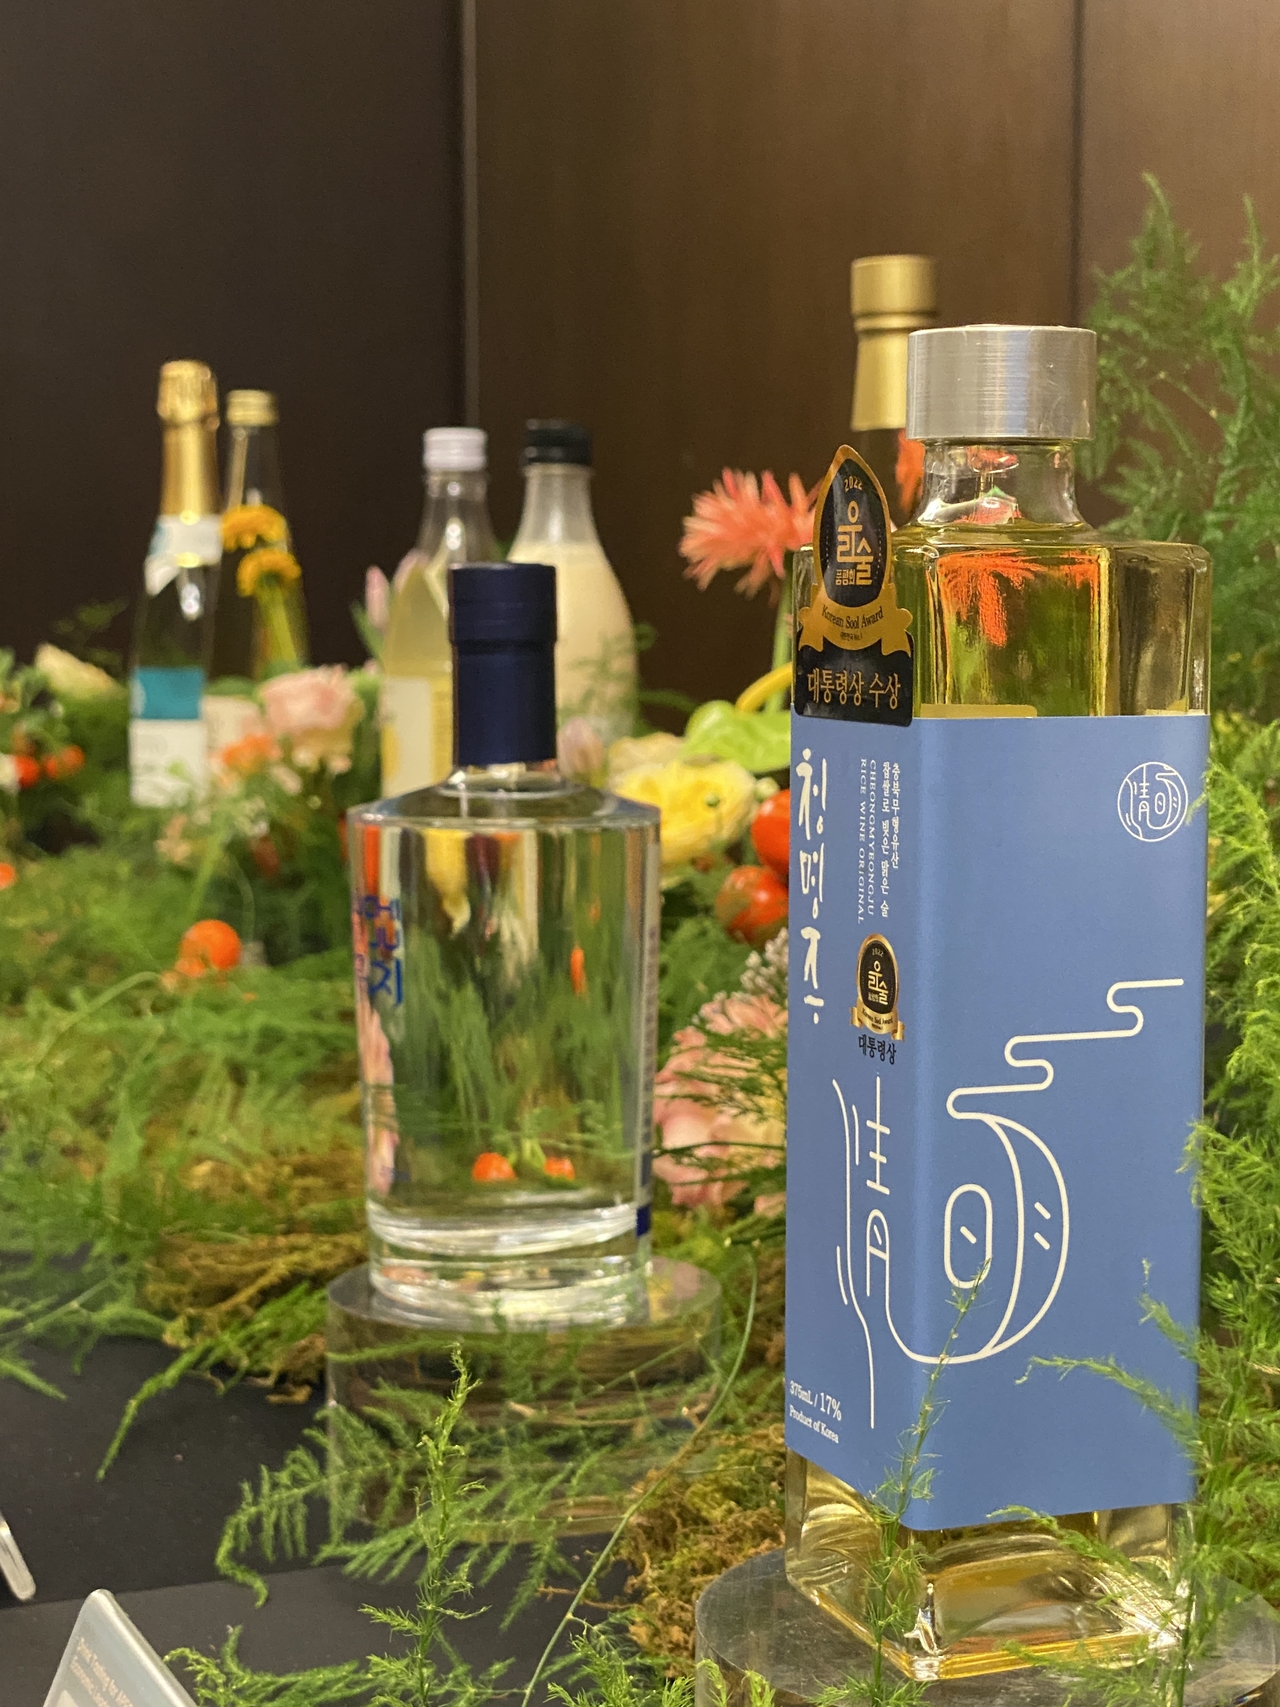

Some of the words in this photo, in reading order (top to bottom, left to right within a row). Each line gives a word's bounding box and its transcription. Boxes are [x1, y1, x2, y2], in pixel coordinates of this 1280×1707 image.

[822, 604, 844, 628] Korean
[846, 615, 859, 629] Sool
[861, 605, 883, 628] Award
[807, 667, 864, 706] 대통령상
[869, 673, 901, 709] 수상
[859, 758, 867, 795] RICE
[881, 761, 890, 813] 찹쌀로
[858, 801, 866, 842] WINE
[867, 760, 876, 916] CHEONGMYEONGJU
[881, 819, 889, 855] 빚은
[857, 848, 865, 924] ORIGINAL
[880, 860, 889, 895] 맑은
[880, 901, 889, 918] 술
[858, 1034, 897, 1065] 대통령상
[790, 1380, 813, 1405] 375mL
[820, 1392, 842, 1421] 17%
[789, 1404, 812, 1428] Product
[813, 1420, 821, 1433] of
[820, 1422, 839, 1444] Korea
